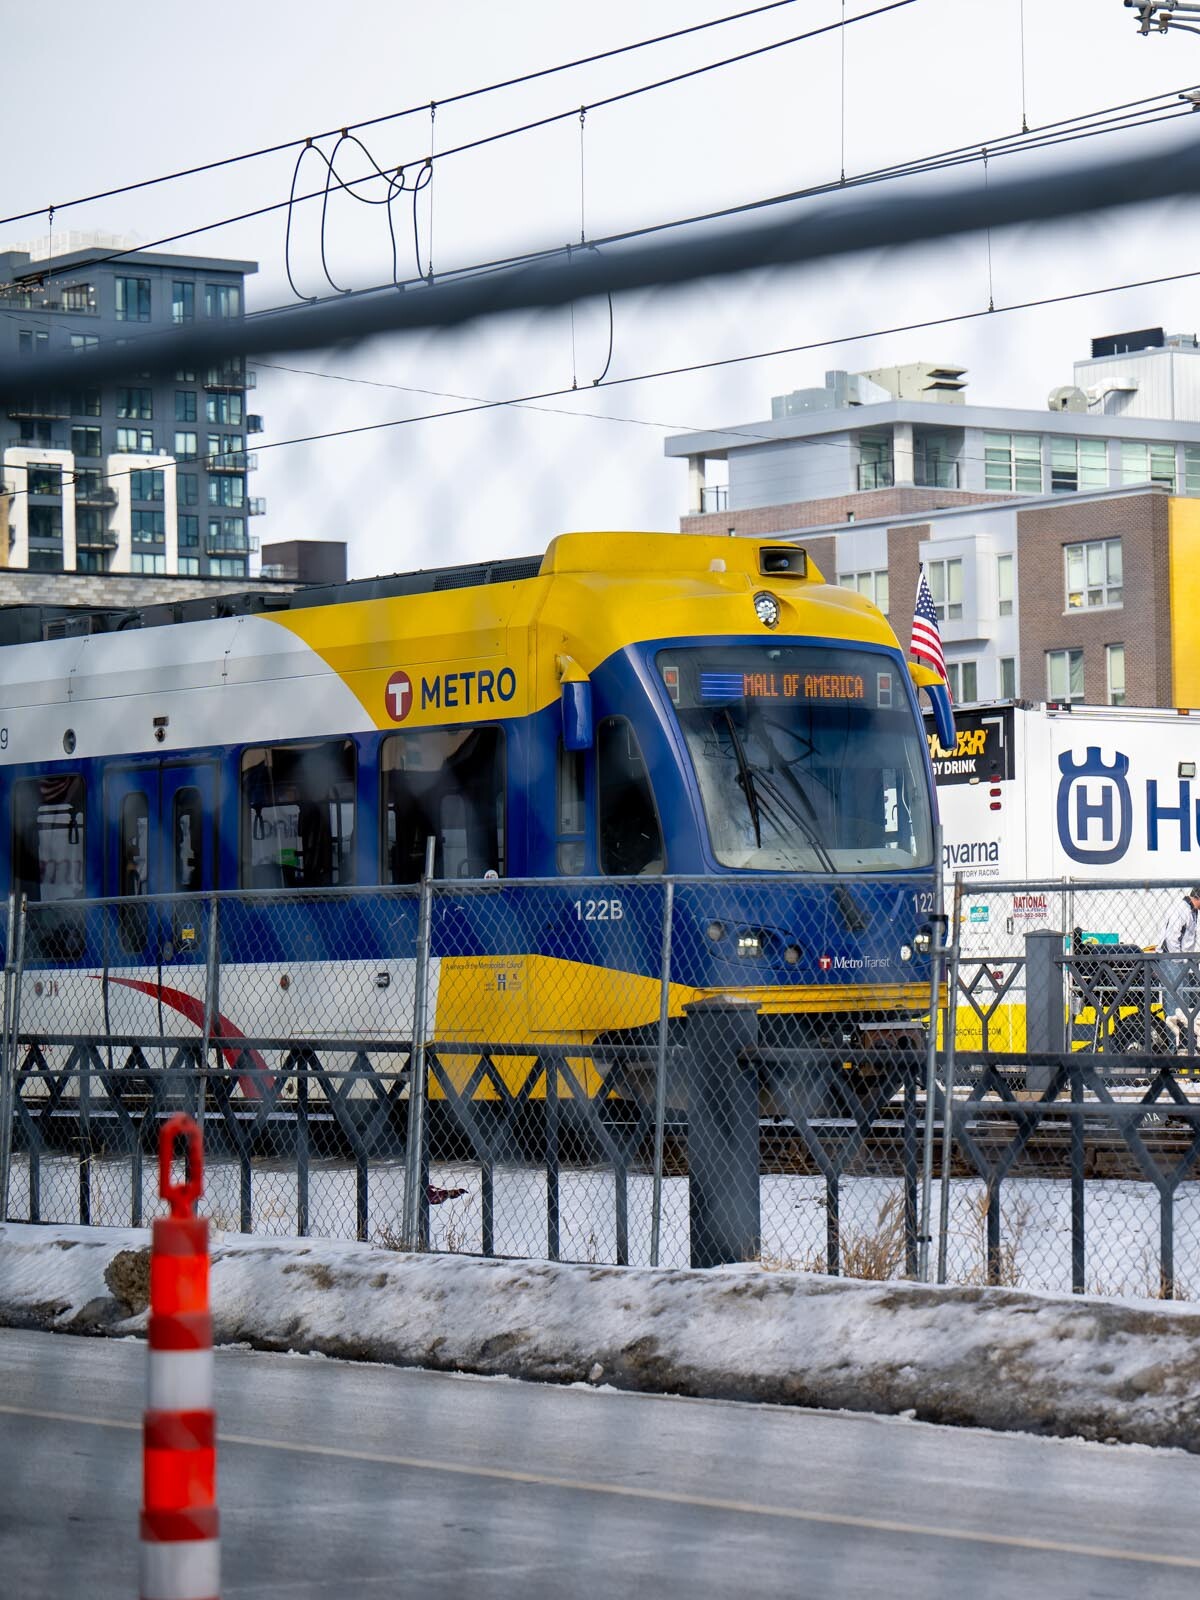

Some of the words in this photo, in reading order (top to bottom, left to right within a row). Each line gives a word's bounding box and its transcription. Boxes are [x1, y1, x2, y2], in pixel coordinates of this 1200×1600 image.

[421, 667, 517, 710] METRO
[743, 673, 779, 697] MALL
[784, 674, 799, 697] OF
[804, 675, 864, 698] AMERICA
[944, 759, 976, 775] DRINK
[978, 869, 999, 877] RACING
[574, 899, 623, 921] 122B
[1013, 896, 1047, 908] NATIONAL
